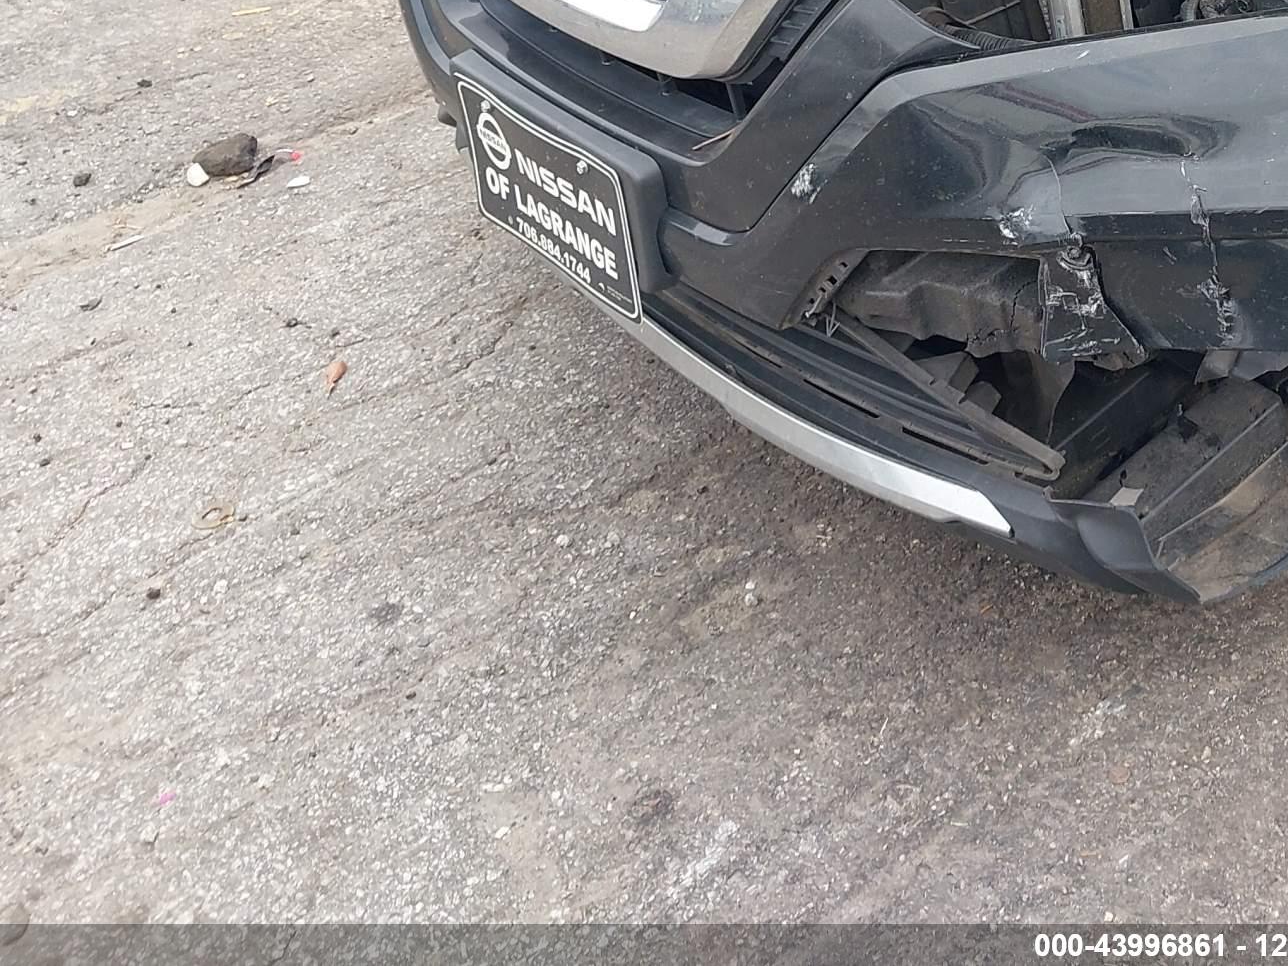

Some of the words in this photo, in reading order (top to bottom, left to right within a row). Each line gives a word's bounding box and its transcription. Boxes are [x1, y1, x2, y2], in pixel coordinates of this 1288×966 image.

[485, 167, 510, 200] OF
[514, 184, 619, 280] LAGRANGE
[514, 148, 617, 236] NISSAN
[516, 217, 591, 284] 706.884.1744
